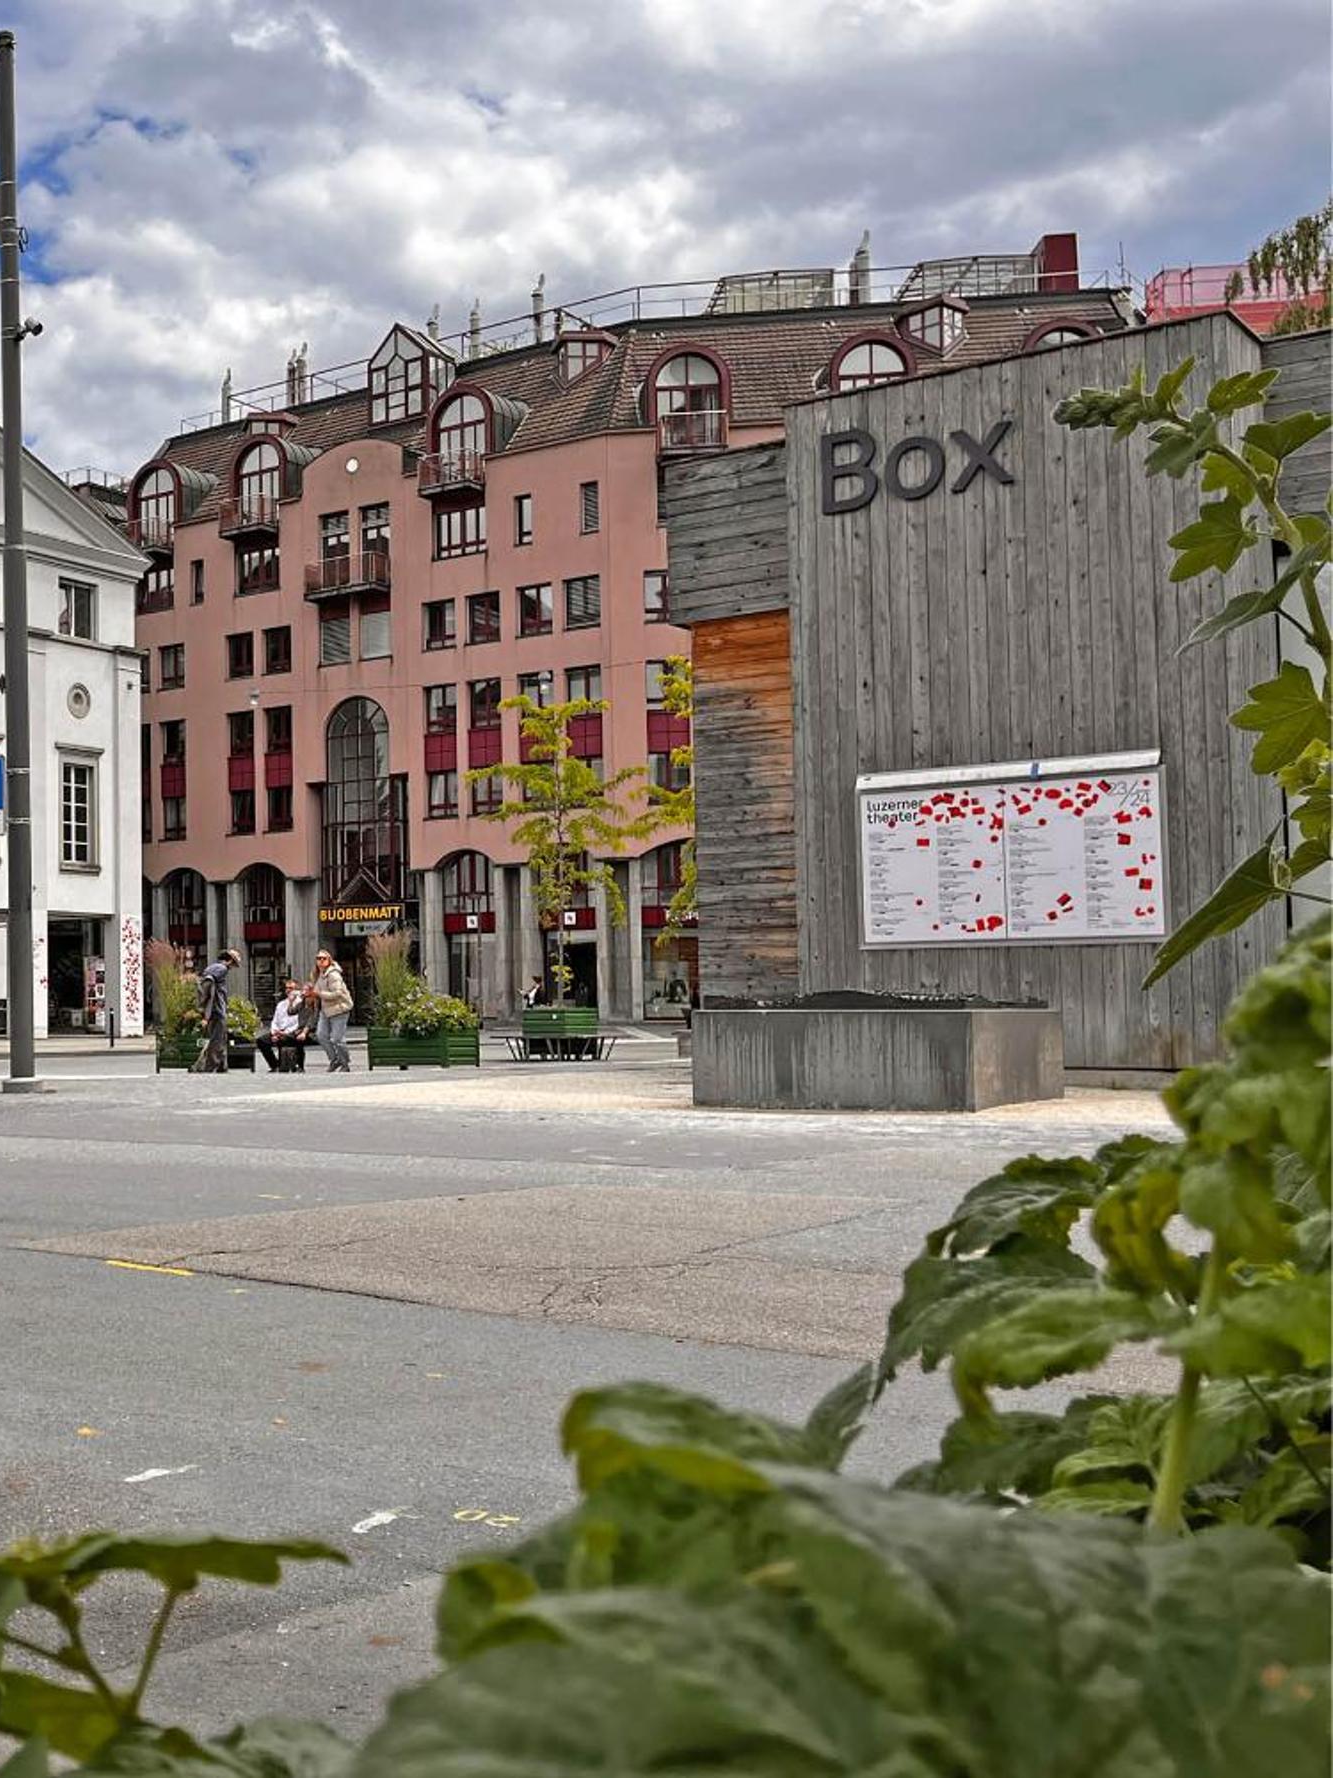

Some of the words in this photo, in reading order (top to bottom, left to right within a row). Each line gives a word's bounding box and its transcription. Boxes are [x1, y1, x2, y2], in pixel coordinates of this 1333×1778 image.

[821, 421, 1015, 516] BOX
[866, 799, 923, 813] luzerner
[867, 811, 918, 824] theater
[319, 906, 401, 921] BUOBENMATT
